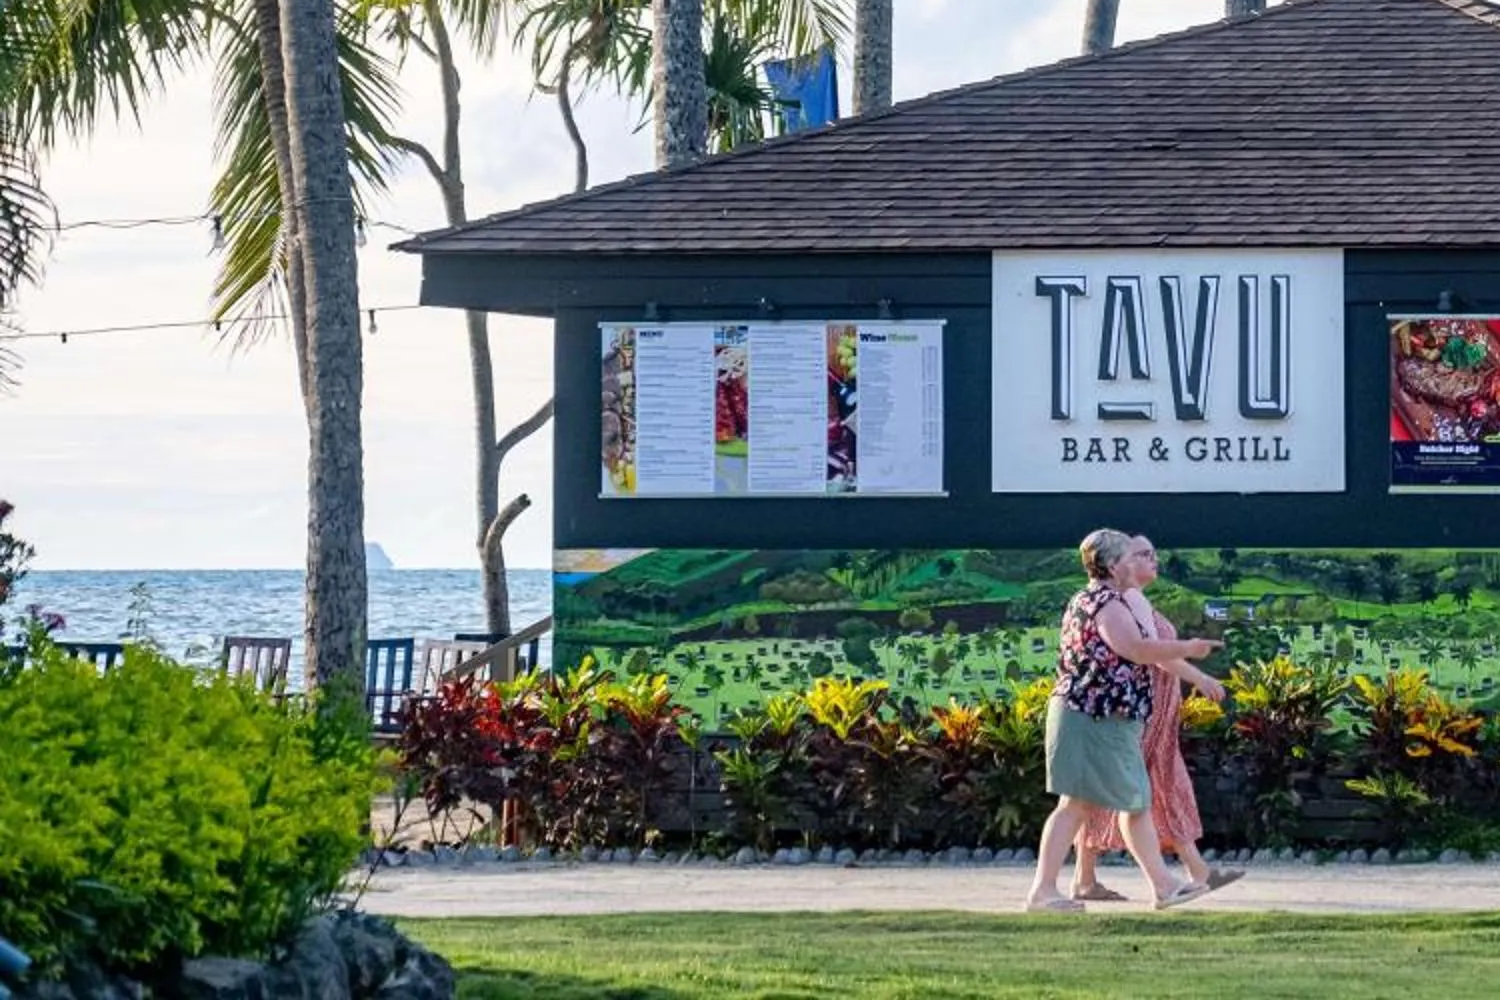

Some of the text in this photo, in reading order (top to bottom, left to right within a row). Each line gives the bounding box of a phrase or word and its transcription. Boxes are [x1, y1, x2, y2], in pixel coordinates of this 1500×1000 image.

[1036, 276, 1291, 421] TAVU
[1062, 437, 1291, 463] BAR & GRILL
